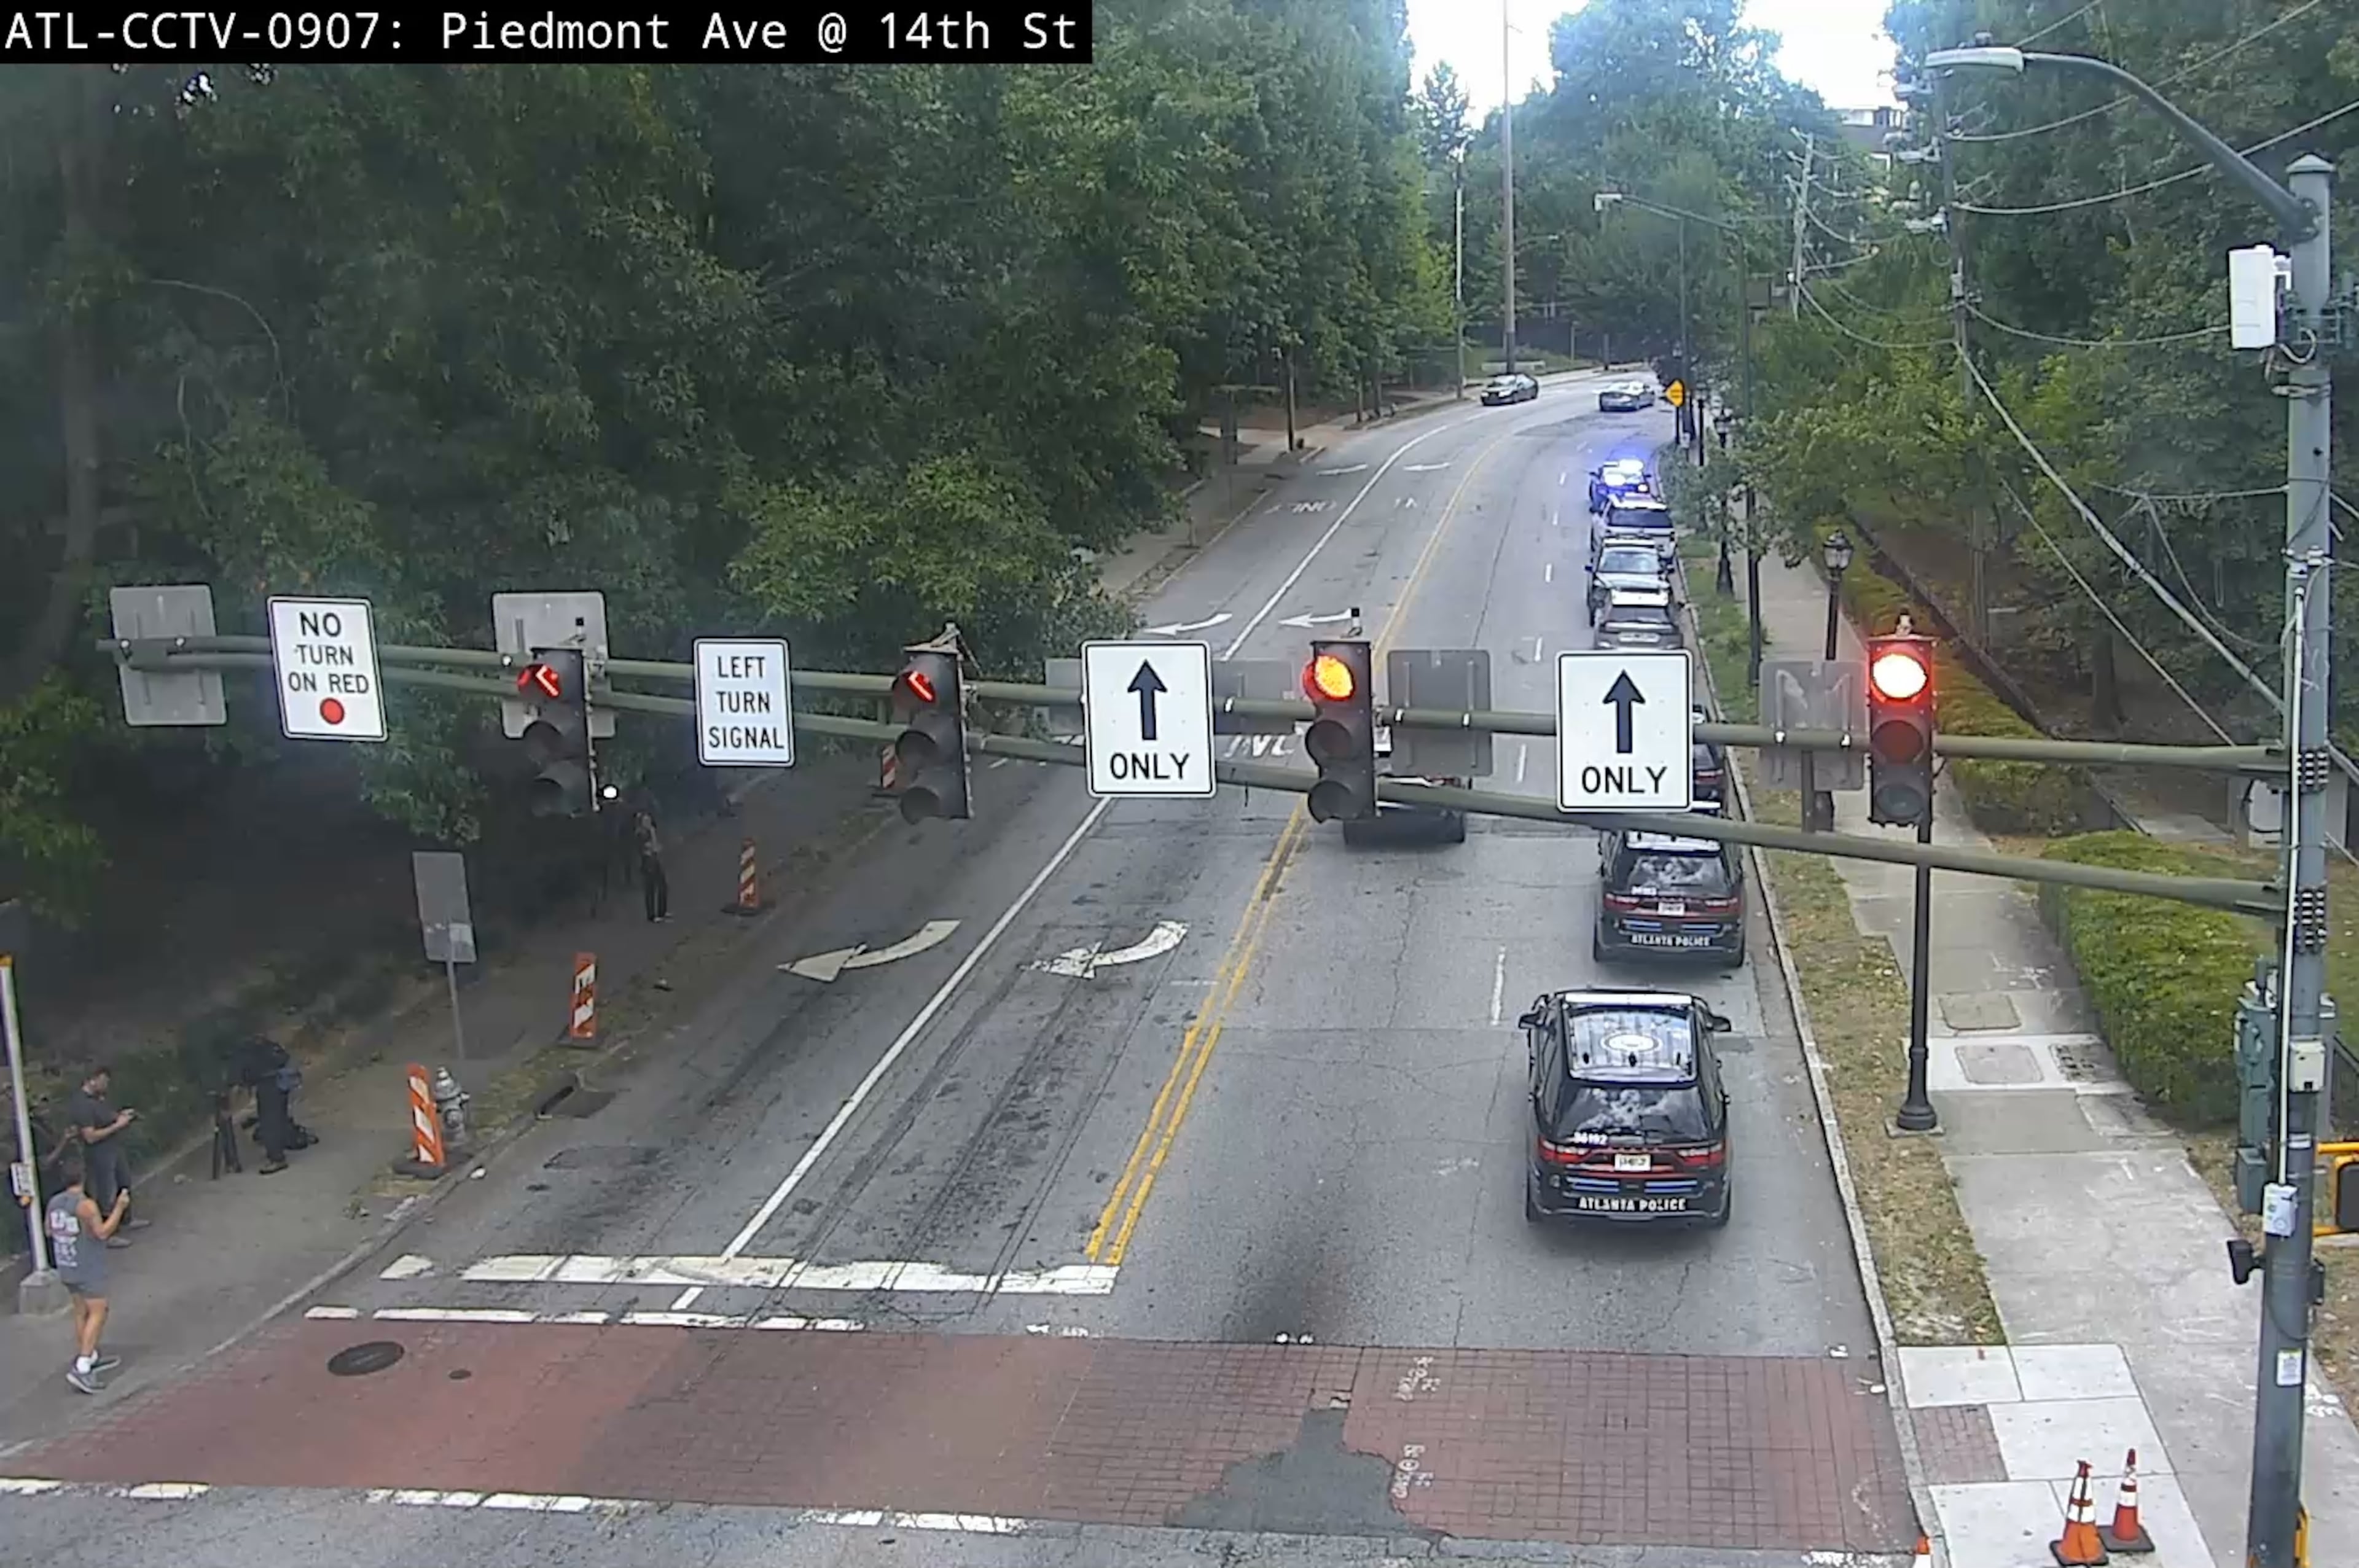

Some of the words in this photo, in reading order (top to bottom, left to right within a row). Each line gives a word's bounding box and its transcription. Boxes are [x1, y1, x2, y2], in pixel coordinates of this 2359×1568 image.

[299, 611, 342, 638] NO
[296, 644, 354, 666] TURN
[716, 655, 766, 679] LEFT
[288, 671, 318, 692] ON
[328, 673, 370, 695] RED
[715, 690, 770, 714] TURN
[708, 725, 785, 749] SIGNAL
[1109, 752, 1191, 781] ONLY
[1581, 765, 1668, 795] ONLY
[1631, 934, 1673, 946] ATLANTA
[1675, 935, 1710, 947] POLICE
[1578, 1196, 1635, 1211] ATLANTA
[1639, 1198, 1686, 1212] POLICE
